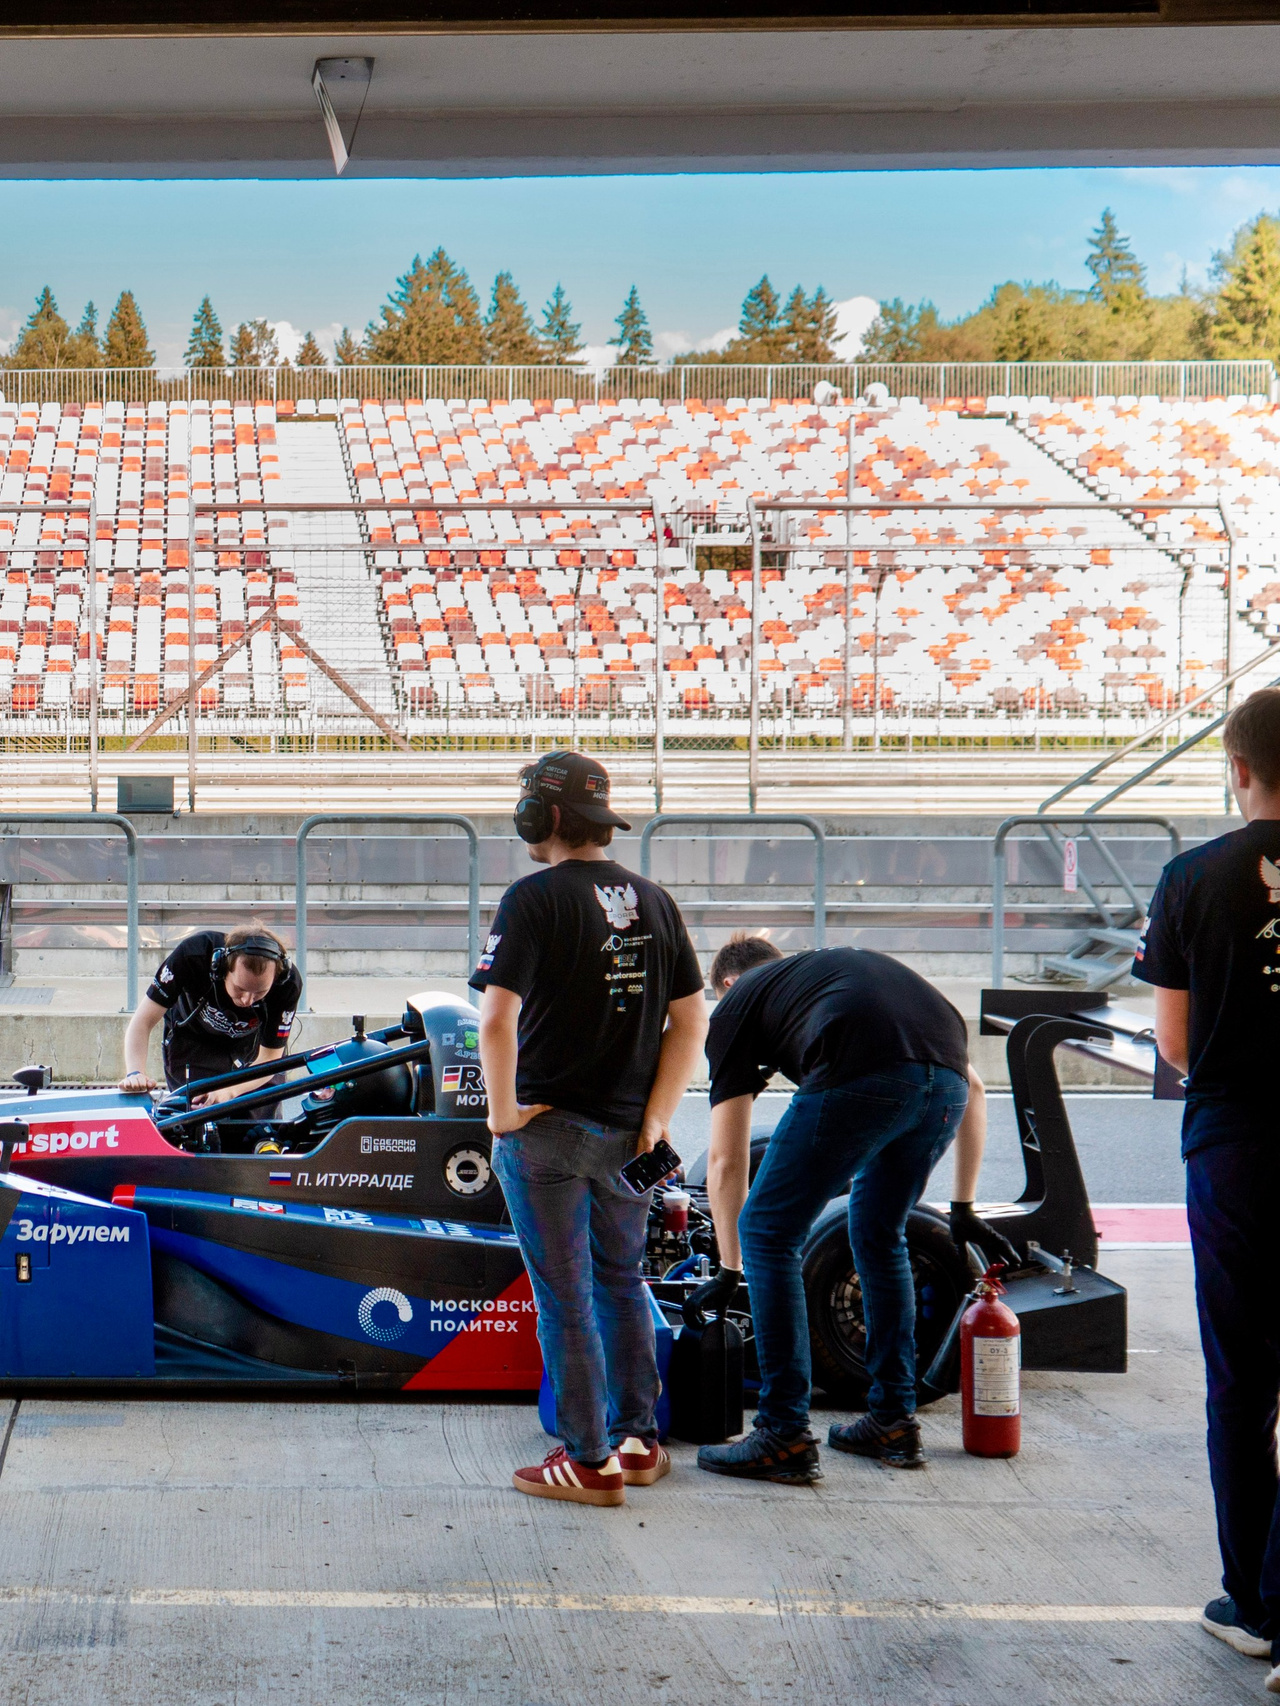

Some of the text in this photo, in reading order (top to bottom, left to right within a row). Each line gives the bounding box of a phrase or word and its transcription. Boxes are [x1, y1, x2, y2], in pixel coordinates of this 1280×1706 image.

[456, 1094, 488, 1106] MOT
[296, 1172, 415, 1190] П. ИТУРРАЛДЕ
